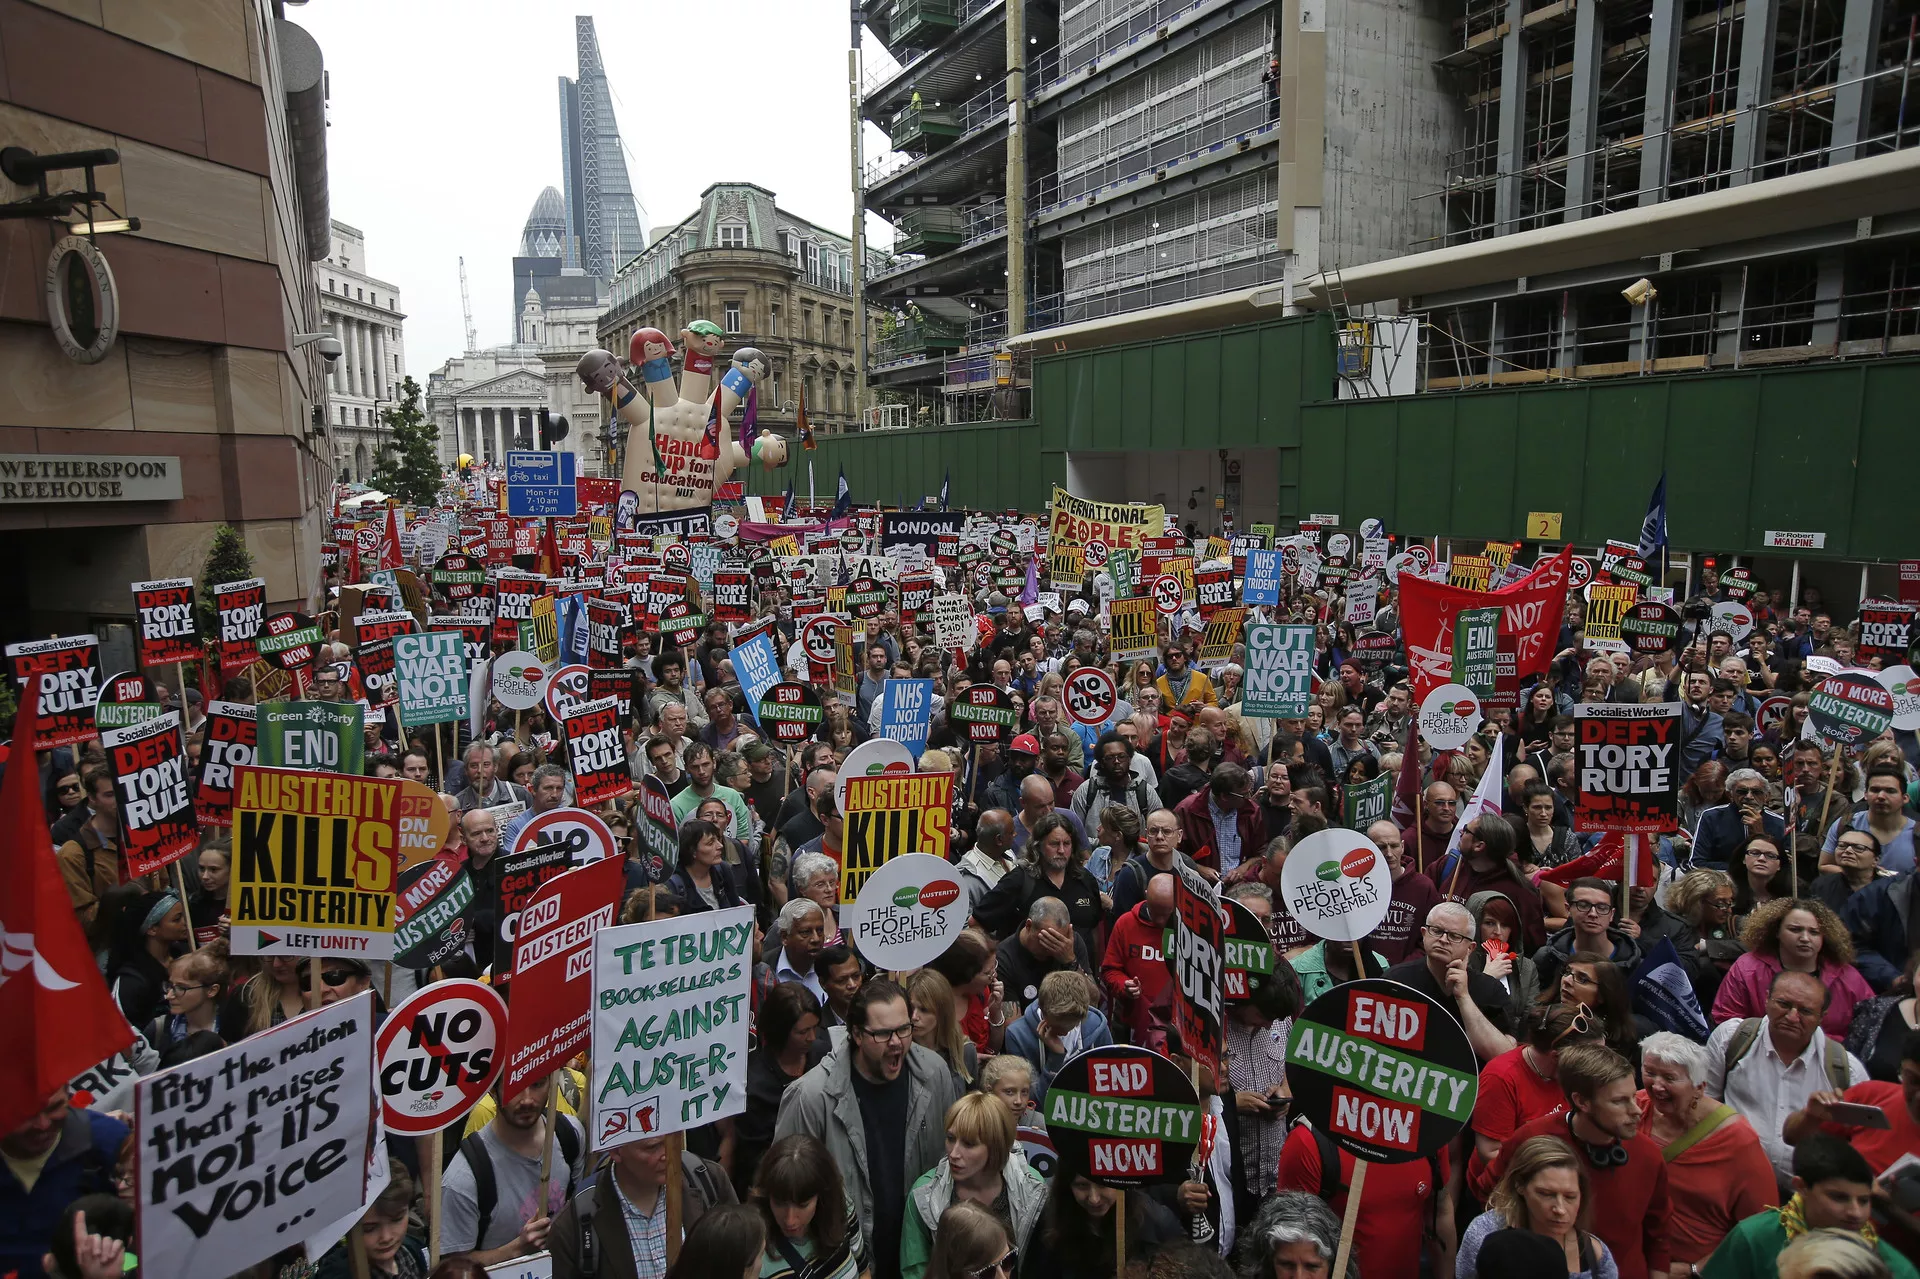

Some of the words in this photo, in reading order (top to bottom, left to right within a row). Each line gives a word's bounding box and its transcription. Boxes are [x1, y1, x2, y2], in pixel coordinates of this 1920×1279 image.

[1, 461, 167, 478] WETHERSPOON
[689, 459, 711, 474] for
[533, 473, 549, 481] taxi
[641, 471, 713, 489] education
[675, 488, 695, 498] NUT
[491, 522, 508, 531] JOBS
[889, 521, 954, 535] LONDON
[1539, 520, 1549, 537] 2
[489, 539, 513, 549] TRIDENT
[568, 540, 586, 550] JOBS
[655, 537, 676, 545] CLIMATE
[1249, 538, 1260, 547] TO
[693, 549, 718, 560] CUT
[1253, 552, 1276, 570] NHS
[435, 571, 483, 583] AUSTERITY
[997, 577, 1026, 586] AUSTERITY
[1247, 577, 1278, 591] TRIDENT
[450, 584, 472, 597] NOW
[846, 591, 887, 604] AUSTERITY
[901, 590, 932, 602] TORY
[1006, 587, 1019, 595] NOW
[1590, 585, 1636, 600] AUSTERITY
[670, 603, 687, 617] END
[938, 599, 963, 607] WHAT
[1111, 599, 1155, 615] AUSTERITY
[1640, 607, 1662, 619] END
[139, 603, 192, 624] TORY
[590, 610, 618, 625] DEFY
[660, 615, 704, 632] AUSTERITY
[935, 613, 969, 623] CHURCH
[1347, 611, 1372, 622] CUTS
[1506, 600, 1547, 633] NOT
[1863, 611, 1911, 623] DEFY
[143, 619, 195, 640] RULE
[271, 616, 294, 634] END
[590, 622, 619, 638] TORY
[1111, 612, 1156, 638] KILLS
[1622, 617, 1679, 637] AUSTERITY
[1862, 624, 1911, 635] TORY
[259, 628, 318, 652] AUSTERITY
[676, 629, 696, 643] NOW
[1112, 634, 1156, 651] AUSTERITY
[1250, 626, 1314, 650] CUT
[1369, 637, 1391, 647] MORE
[1467, 625, 1494, 650] END
[396, 633, 460, 660] CUT
[738, 639, 768, 674] NHS
[1351, 650, 1396, 660] AUSTERITY
[1250, 650, 1310, 670] WAR
[117, 680, 143, 701] END
[400, 674, 464, 700] NOT
[591, 680, 610, 689] Get
[1074, 676, 1100, 695] NO
[1246, 669, 1309, 693] NOT
[402, 694, 467, 711] WELFARE
[778, 688, 801, 702] END
[894, 682, 924, 709] NHS
[1070, 691, 1111, 712] CUTS
[1246, 690, 1307, 702] WELFARE
[1823, 680, 1844, 696] NO
[1847, 685, 1888, 706] MORE
[267, 711, 303, 722] Green
[328, 714, 355, 726] Party
[760, 703, 820, 721] AUSTERITY
[895, 709, 919, 724] NOT
[954, 705, 1013, 724] AUSTERITY
[1809, 693, 1891, 733] AUSTERITY
[567, 708, 618, 738] DEFY
[778, 723, 805, 737] NOW
[884, 723, 926, 742] TRIDENT
[1422, 717, 1468, 728] PEOPLE'S
[1431, 726, 1469, 735] ASSEMBLY
[1581, 719, 1674, 745] DEFY
[284, 729, 339, 765] END
[569, 725, 621, 757] TORY
[113, 728, 180, 776] DEFY
[573, 744, 625, 775] RULE
[1579, 743, 1674, 769] TORY
[117, 754, 183, 802] TORY
[1581, 768, 1670, 794] RULE
[239, 771, 397, 820] AUSTERITY
[849, 776, 951, 810] AUSTERITY
[1349, 788, 1367, 797] Green
[124, 781, 189, 830] RULE
[648, 795, 671, 825] MORE
[636, 805, 678, 865] AUSTERITY
[1608, 824, 1634, 832] march,
[1635, 823, 1661, 832] occupy
[240, 811, 393, 891] KILLS
[1318, 866, 1339, 876] AGAINST
[405, 860, 453, 906] MORE
[501, 871, 535, 892] Get
[1296, 880, 1327, 897] THE
[895, 893, 918, 901] AGAINST
[1293, 876, 1374, 914] PEOPLE'S
[1317, 889, 1378, 920] ASSEMBLY
[237, 886, 390, 927] AUSTERITY
[523, 899, 558, 931] END
[867, 906, 898, 921] THE
[1390, 900, 1417, 914] SOUTH
[859, 909, 946, 939] PEOPLE'S
[519, 904, 613, 969] AUSTERITY
[878, 923, 949, 947] ASSEMBLY
[614, 920, 754, 976] TETBURY
[570, 951, 592, 975] NO
[600, 963, 741, 1011] BOOKSELLERS
[614, 993, 746, 1052] AGAINST
[1353, 996, 1420, 1041] END
[407, 1008, 482, 1050] NO
[510, 1033, 549, 1066] Labour
[551, 1009, 592, 1040] Assemb
[151, 1072, 214, 1115] Pity
[218, 1052, 274, 1090] the
[280, 1018, 357, 1065] nation
[380, 1048, 493, 1096] CUTS
[509, 1049, 551, 1085] Against
[598, 1043, 736, 1105] AUSTER-
[1294, 1028, 1469, 1112] AUSTERITY
[1093, 1063, 1148, 1092] END
[148, 1098, 236, 1163] that
[247, 1056, 345, 1119] raises
[681, 1082, 731, 1123] ITY
[1051, 1095, 1195, 1138] AUSTERITY
[1336, 1094, 1414, 1144] NOW
[152, 1121, 263, 1205] not
[1093, 1143, 1157, 1172] NOW
